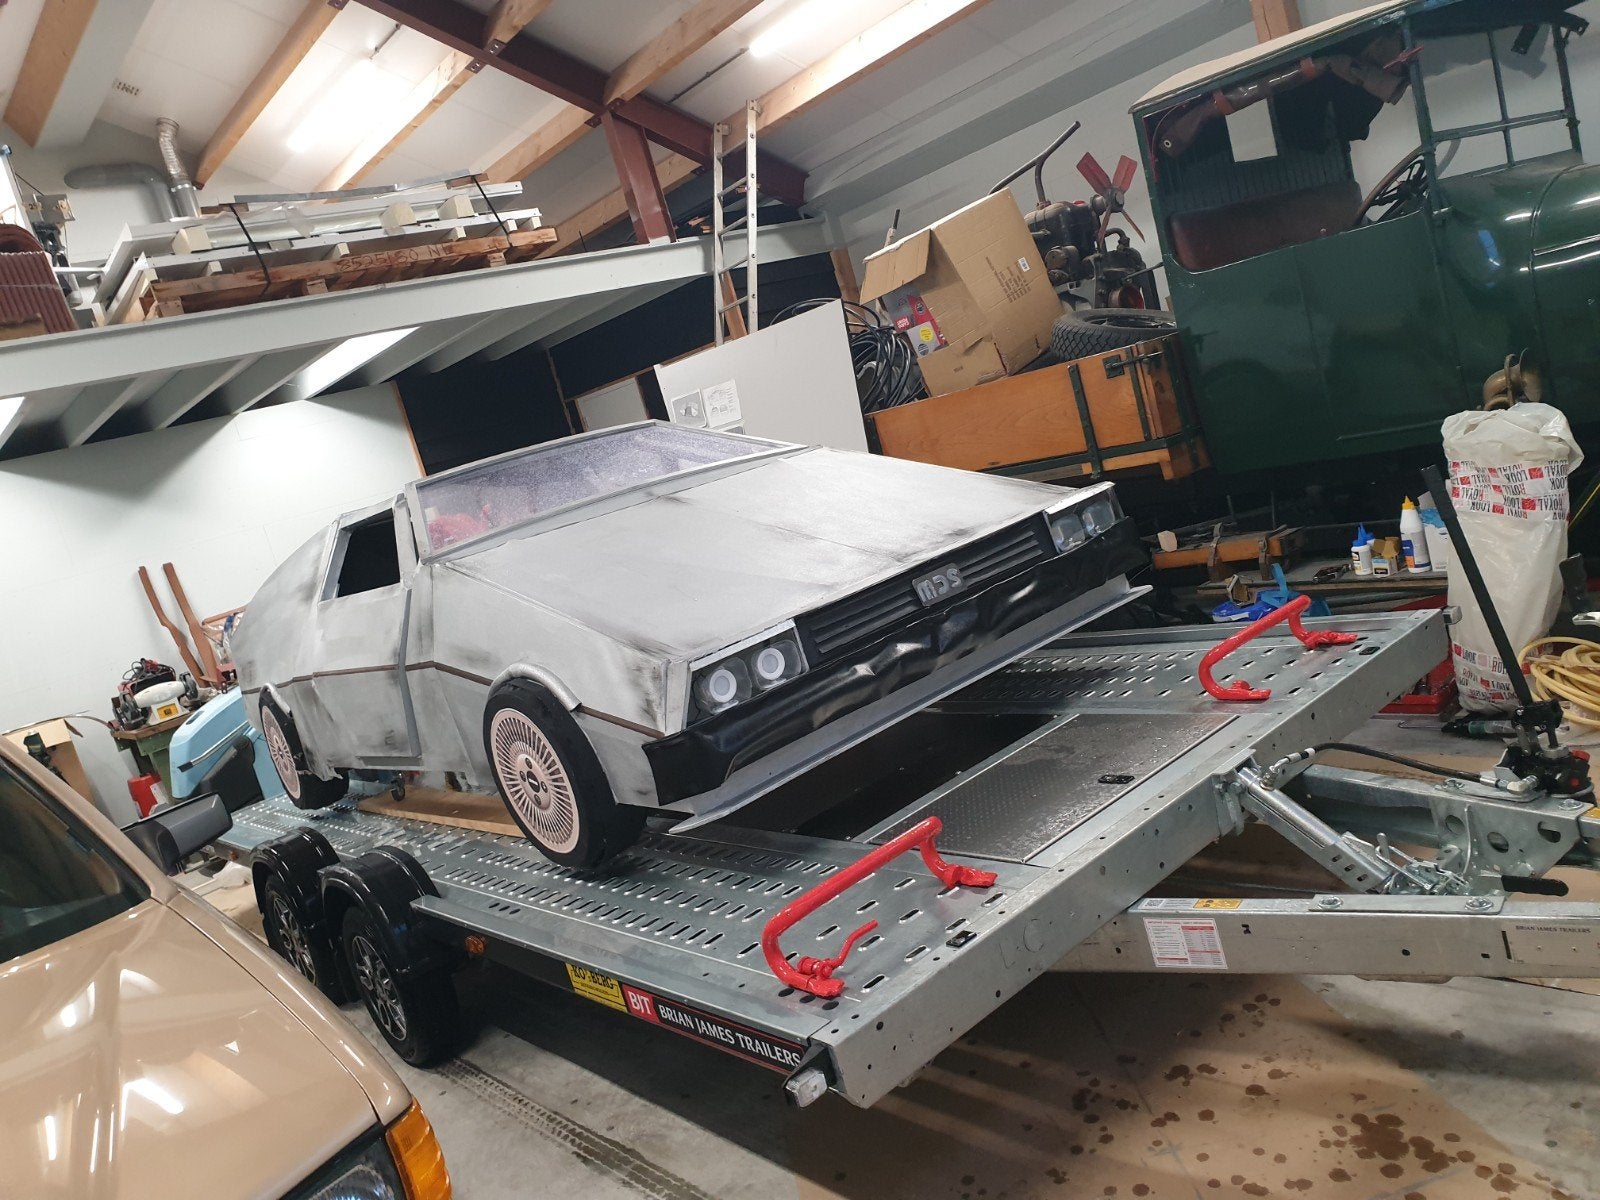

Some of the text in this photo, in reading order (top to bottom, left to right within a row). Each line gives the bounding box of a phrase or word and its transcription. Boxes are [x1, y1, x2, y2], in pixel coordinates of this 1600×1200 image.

[627, 990, 652, 1015] BIT
[658, 1004, 801, 1068] BRIAN JAMES TRAILERS
